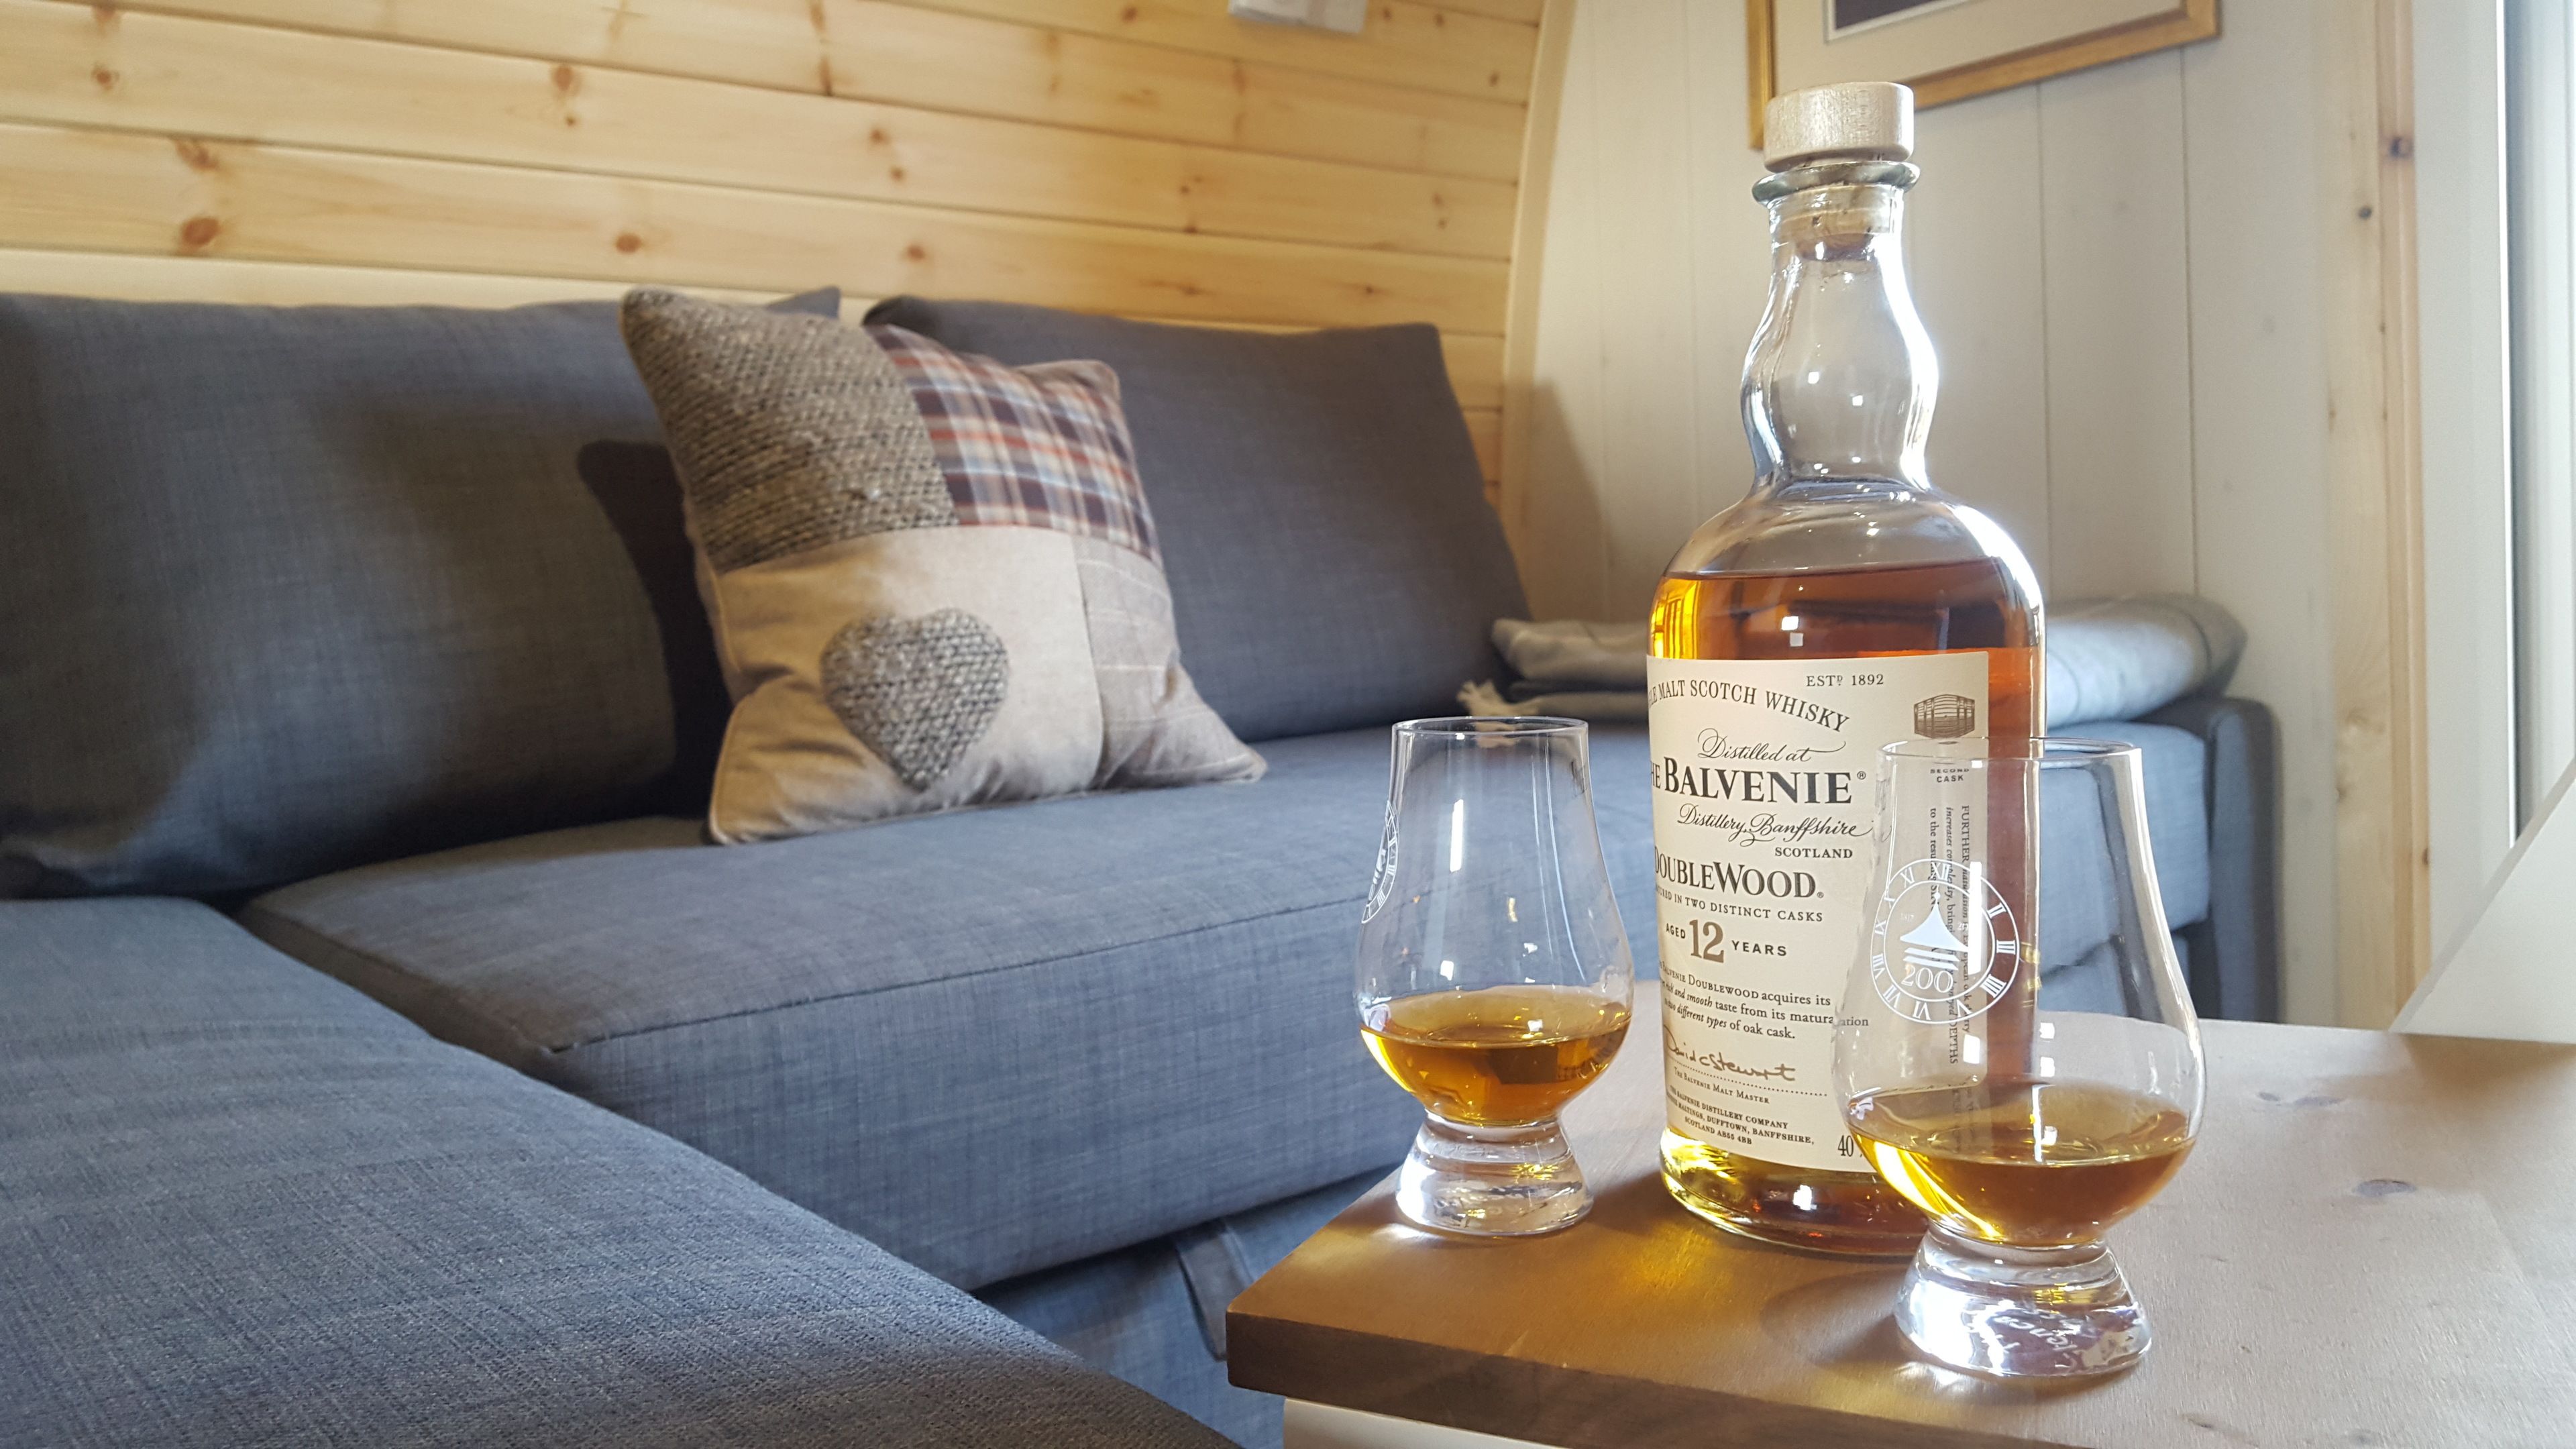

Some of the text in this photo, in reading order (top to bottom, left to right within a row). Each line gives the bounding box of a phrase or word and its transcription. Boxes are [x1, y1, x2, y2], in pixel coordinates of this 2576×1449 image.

[1851, 674, 1884, 686] 1892
[1659, 680, 1685, 700] MALT
[1690, 680, 1758, 705] SCOTCH
[1766, 690, 1850, 733] WHISKY
[1697, 728, 1784, 762] Distilled
[1936, 774, 1964, 783] CASK
[1930, 808, 1937, 818] to
[1945, 807, 1954, 847] increases
[1740, 813, 1874, 847] Banffshire
[1930, 822, 1939, 837] the
[1961, 805, 1970, 863] FURTHER
[1774, 847, 1854, 859] SCOTLAND
[1674, 889, 1682, 904] IN
[1685, 896, 1706, 910] TWO
[1710, 902, 1771, 919] DISTINCT
[1778, 910, 1823, 922] CASKS
[1666, 919, 1787, 963] AGED 12 YEARS
[1996, 940, 2017, 955] III
[1688, 974, 1759, 999] DOUBLEWOOD
[1761, 991, 1812, 1006] acquires
[1815, 994, 1831, 1006] its
[1900, 963, 1954, 994] 200
[1674, 987, 1685, 1000] and
[1686, 994, 1713, 1008] smooth
[1715, 1000, 1738, 1014] taste
[1740, 1003, 1768, 1018] from
[1772, 1008, 1786, 1020] its
[1676, 1003, 1705, 1022] different
[1706, 1016, 1727, 1029] types
[1729, 1020, 1741, 1031] of
[1743, 1023, 1764, 1036] oak
[1766, 1026, 1796, 1039] cask.
[1684, 1073, 1711, 1090] BALVENIE
[1713, 1083, 1733, 1096] MALT
[1736, 1090, 1770, 1104] MASTER
[1684, 1116, 1715, 1134] SCOTLAND
[1702, 1101, 1743, 1120] DISTILLERY
[1746, 1114, 1788, 1129] COMPANY
[1752, 1128, 1815, 1145] BANFFSHIRE,
